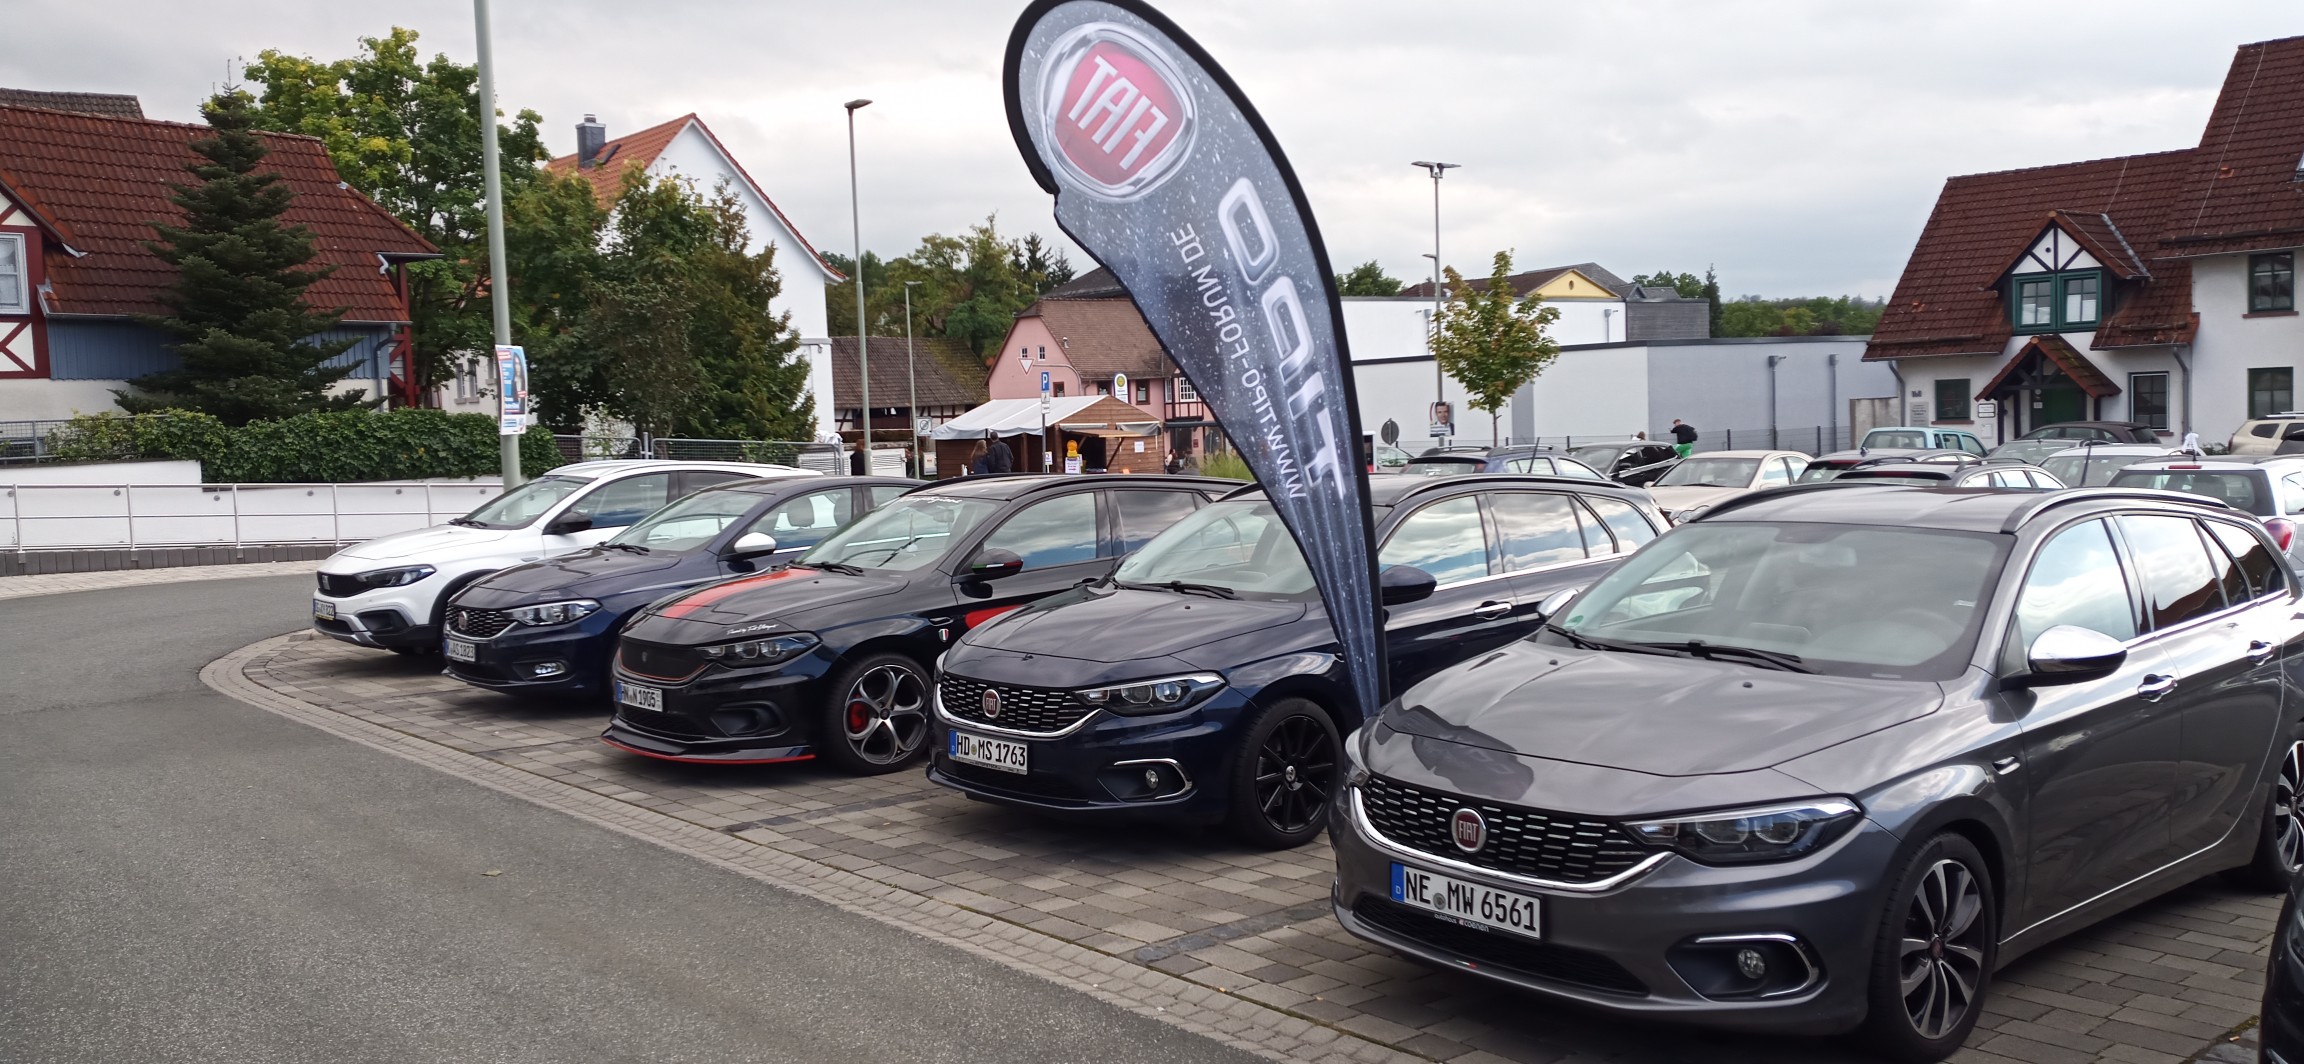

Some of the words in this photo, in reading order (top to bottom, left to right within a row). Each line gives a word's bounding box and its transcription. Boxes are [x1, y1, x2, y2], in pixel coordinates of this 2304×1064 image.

[638, 689, 656, 708] 1905
[956, 734, 970, 756] HD
[978, 739, 993, 761] MS
[995, 742, 1026, 767] 1763
[1458, 820, 1479, 842] FIAT
[1405, 870, 1431, 905] NE
[1447, 881, 1475, 916] MW
[1481, 890, 1537, 932] 6561
